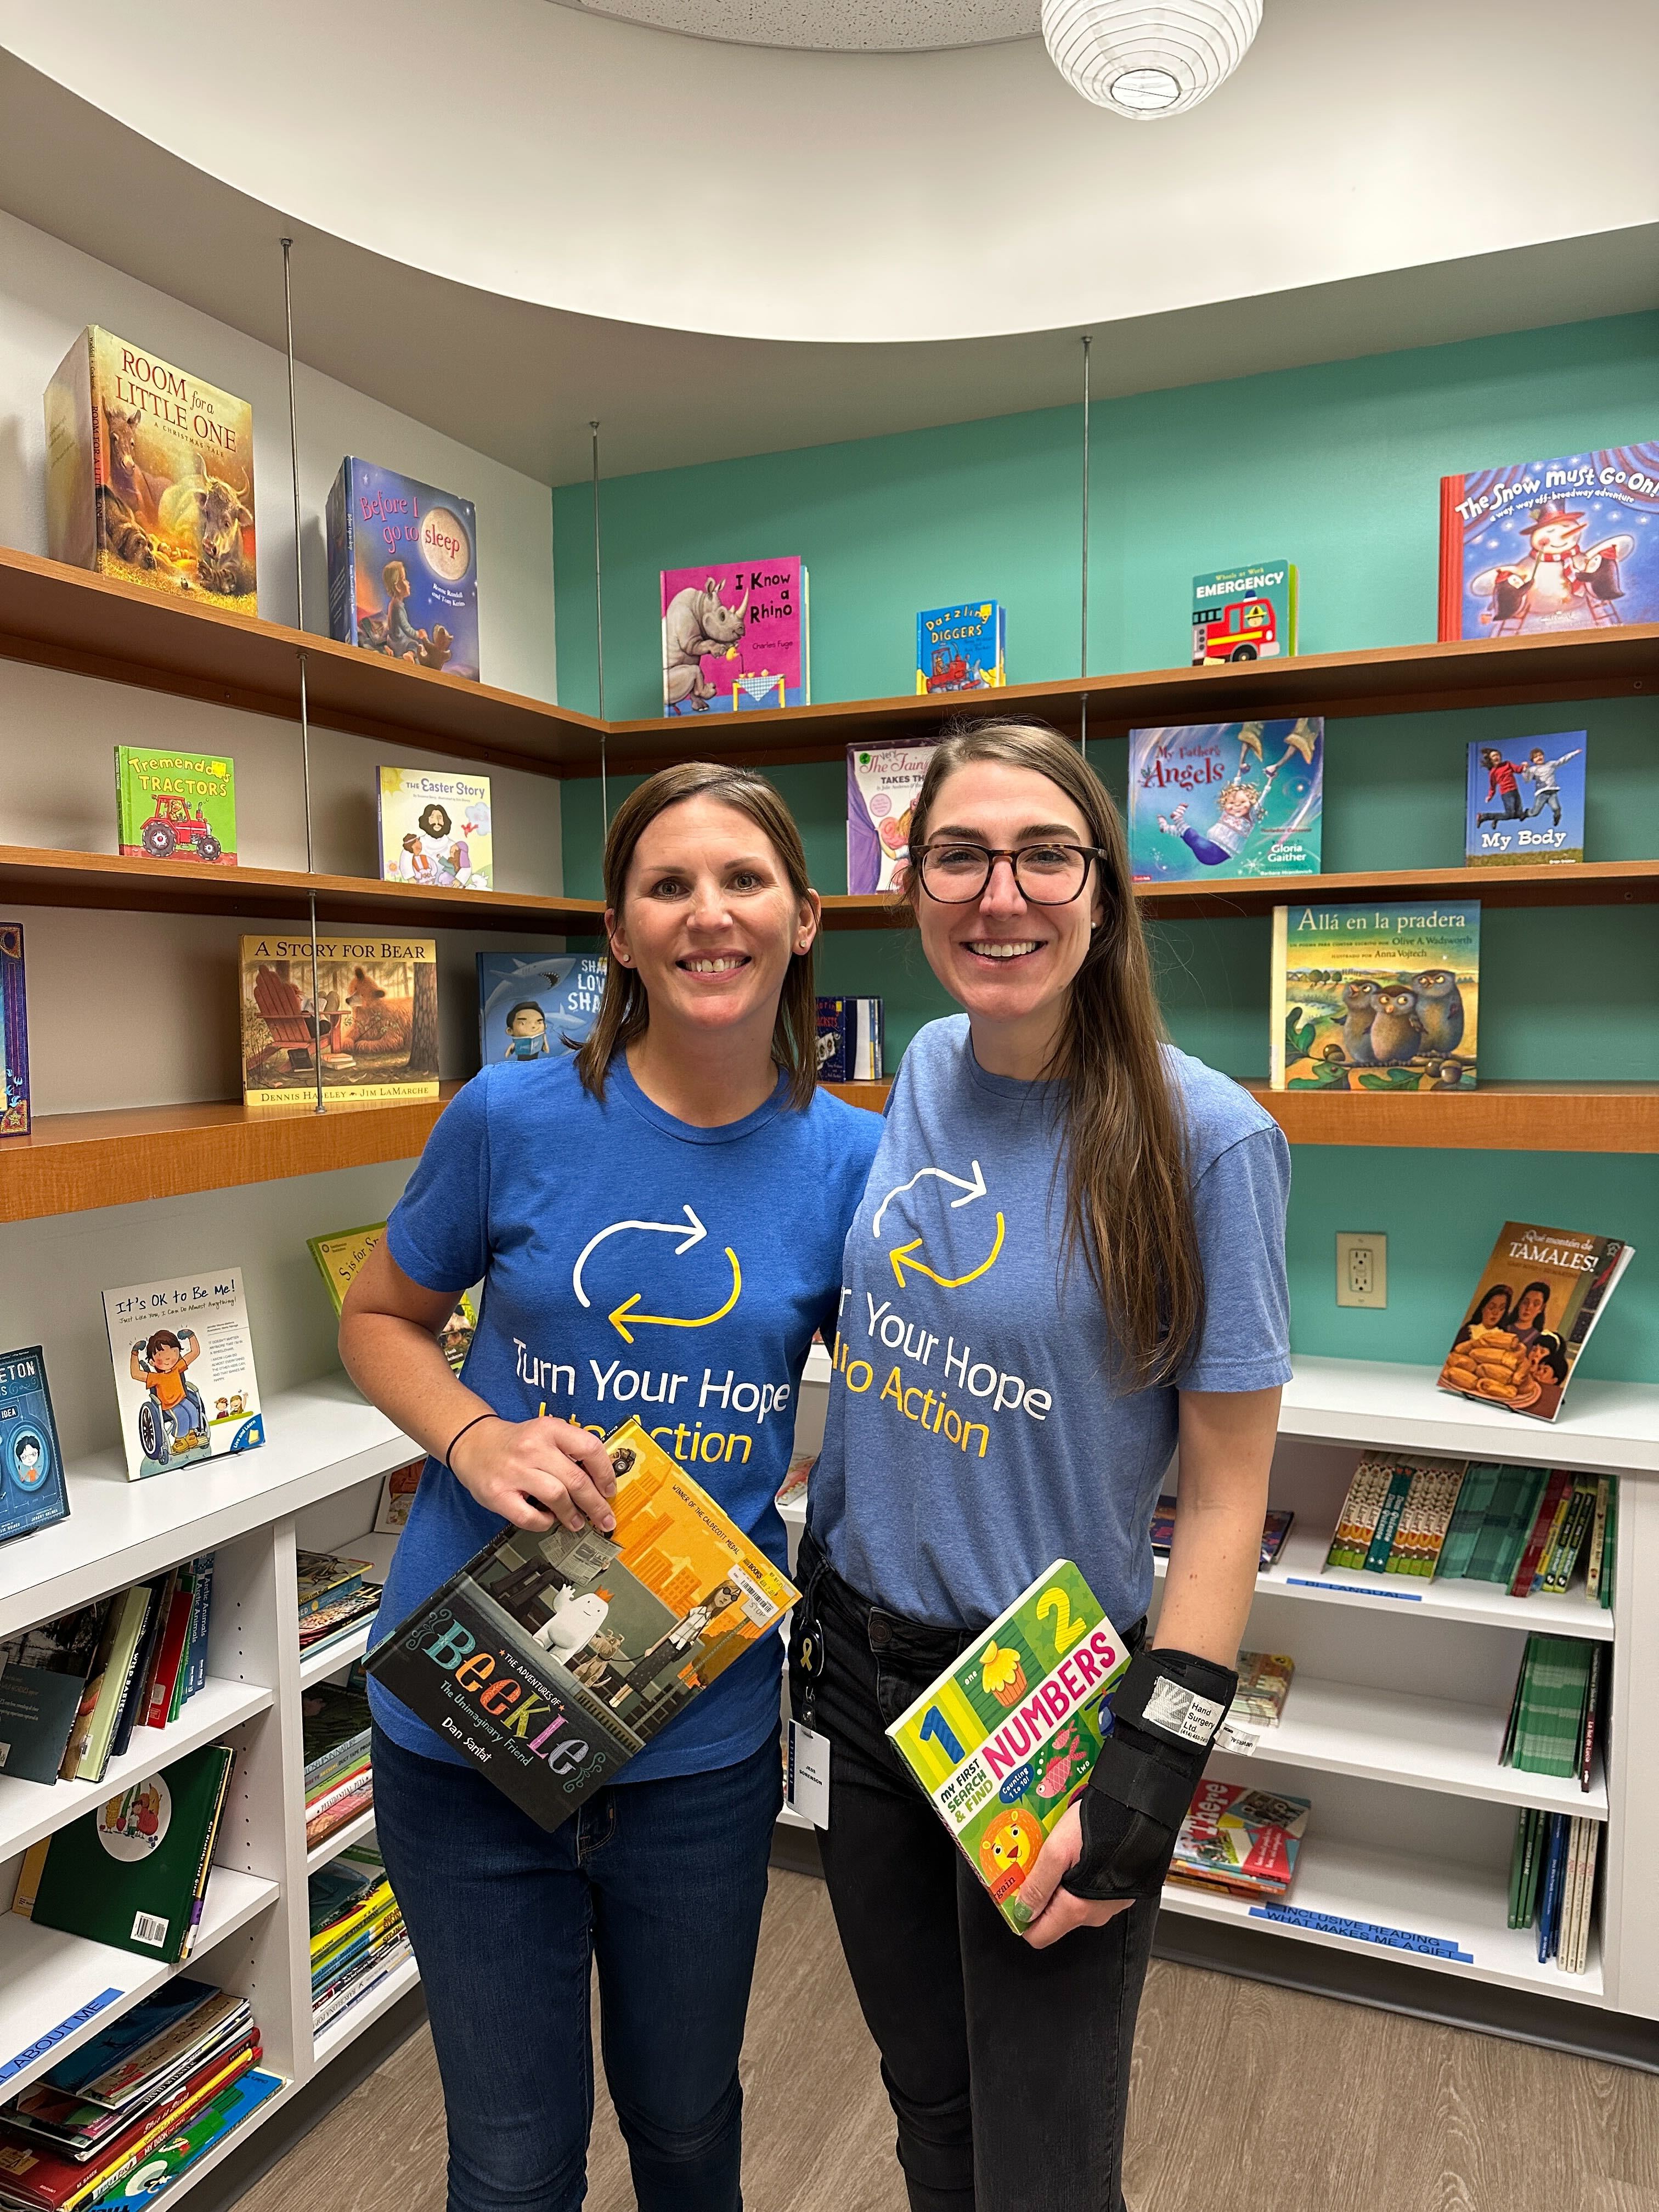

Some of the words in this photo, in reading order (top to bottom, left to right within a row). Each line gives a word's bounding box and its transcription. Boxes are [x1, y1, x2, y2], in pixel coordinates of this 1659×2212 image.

[121, 347, 188, 402] ROOM
[190, 391, 207, 410] for
[207, 403, 215, 415] a
[115, 376, 189, 431] LITTLE
[194, 415, 236, 453] ONE
[163, 425, 204, 449] CHRISTMAS
[207, 445, 225, 458] TALE
[359, 490, 408, 522] Before
[413, 496, 419, 518] I
[1454, 495, 1489, 521] The
[1489, 478, 1541, 510] Snow
[1599, 467, 1626, 486] Go
[1628, 470, 1659, 498] On!
[1516, 501, 1533, 510] way
[1536, 489, 1593, 505] off-broadway
[1594, 488, 1635, 503] adventure
[383, 526, 400, 554] go
[405, 526, 420, 542] to
[425, 524, 460, 559] sleep
[735, 574, 743, 590] I
[751, 572, 791, 590] Know
[1196, 571, 1284, 599] EMERGENCY
[780, 589, 789, 601] a
[750, 603, 793, 624] Rhino
[752, 642, 776, 650] Charles
[777, 640, 793, 650] Fuge
[932, 625, 983, 643] DIGGERS
[859, 753, 888, 774] The
[879, 749, 896, 760] Very
[1155, 746, 1173, 761] My
[1179, 746, 1221, 759] Father's
[138, 775, 227, 797] TRACTORS
[881, 775, 910, 784] TAKES
[1143, 758, 1225, 792] Angels
[421, 778, 454, 793] Easter
[456, 782, 485, 799] Story
[1271, 843, 1303, 853] Gloria
[1482, 832, 1511, 851] My
[1518, 828, 1566, 848] Body
[1267, 853, 1306, 862] Gaither
[1297, 908, 1339, 931] Allá
[1346, 918, 1367, 930] en
[1375, 912, 1390, 929] la
[1397, 911, 1465, 933] pradera
[255, 941, 270, 956] A
[276, 941, 337, 957] STORY
[343, 945, 376, 958] FOR
[381, 944, 426, 958] BEAR
[1392, 936, 1414, 945] Olive
[1426, 934, 1472, 945] Wadsworth
[1374, 950, 1396, 958] Anna
[1398, 948, 1427, 959] Vojtech
[261, 1093, 300, 1102] DENNIS
[303, 1090, 347, 1100] HAELEY
[359, 1088, 377, 1097] JIM
[1508, 1242, 1599, 1272] TAMALES!
[1580, 1239, 1593, 1251] de
[339, 1267, 351, 1281] S
[348, 1262, 357, 1271] is
[354, 1248, 367, 1263] for
[115, 1297, 146, 1314] It's
[151, 1293, 168, 1306] OK
[172, 1290, 187, 1304] to
[193, 1286, 208, 1300] Be
[215, 1279, 235, 1295] Me!
[208, 1297, 236, 1310] Anything!
[867, 1291, 940, 1365] Your
[944, 1335, 1053, 1421] Hope
[512, 1337, 576, 1396] Turn
[589, 1359, 689, 1404] Your
[698, 1368, 791, 1425] Hope
[1, 1408, 16, 1419] IDEA
[879, 1365, 990, 1458] Action
[244, 1420, 256, 1430] Learn
[630, 1413, 752, 1464] ction
[672, 1483, 690, 1506] WINNER
[695, 1507, 704, 1518] THE
[702, 1516, 727, 1541] CALDECOTT
[726, 1539, 740, 1555] MEDAL
[748, 1563, 763, 1579] BOOKS
[192, 1609, 200, 1644] Animals
[201, 1602, 209, 1637] Animals
[1036, 1587, 1088, 1655] 2
[128, 1652, 139, 1677] WILD
[963, 1669, 979, 1686] one
[505, 1652, 517, 1669] THE
[516, 1665, 553, 1702] ADVENTURES
[549, 1696, 562, 1707] OF
[118, 1680, 131, 1713] BABIES
[980, 1630, 1116, 1781] NUMBERS
[1192, 1702, 1212, 1716] Hand
[441, 1680, 454, 1699] The
[454, 1692, 505, 1744] Unimaginary
[503, 1738, 534, 1767] Friend
[1188, 1712, 1215, 1730] Surgery
[442, 1716, 462, 1740] Dan
[462, 1736, 493, 1763] Santat
[919, 1705, 967, 1766] 1
[1001, 1766, 1030, 1795] Counting
[1076, 1759, 1091, 1776] two
[940, 1786, 958, 1804] MY
[954, 1758, 981, 1787] FIRST
[946, 1769, 988, 1815] SEARCH
[1008, 1790, 1014, 1799] 1
[1013, 1786, 1023, 1796] to
[954, 1809, 966, 1824] &
[963, 1779, 994, 1810] FIND
[1267, 1911, 1310, 1928] WHAT
[1316, 1922, 1370, 1940] MAKES
[1374, 1934, 1398, 1947] ME
[1402, 1941, 1414, 1951] A
[1418, 1944, 1455, 1959] GIFT
[1282, 1905, 1365, 1930] INCLUSIVE
[1368, 1925, 1441, 1947] READING
[13, 2022, 74, 2069] ABOUT
[73, 2001, 105, 2021] ME
[143, 2086, 166, 2103] DAVID
[165, 2062, 197, 2085] WIESNER
[144, 2145, 154, 2155] MY
[154, 2131, 168, 2147] BOOK
[83, 2169, 97, 2184] SASEK
